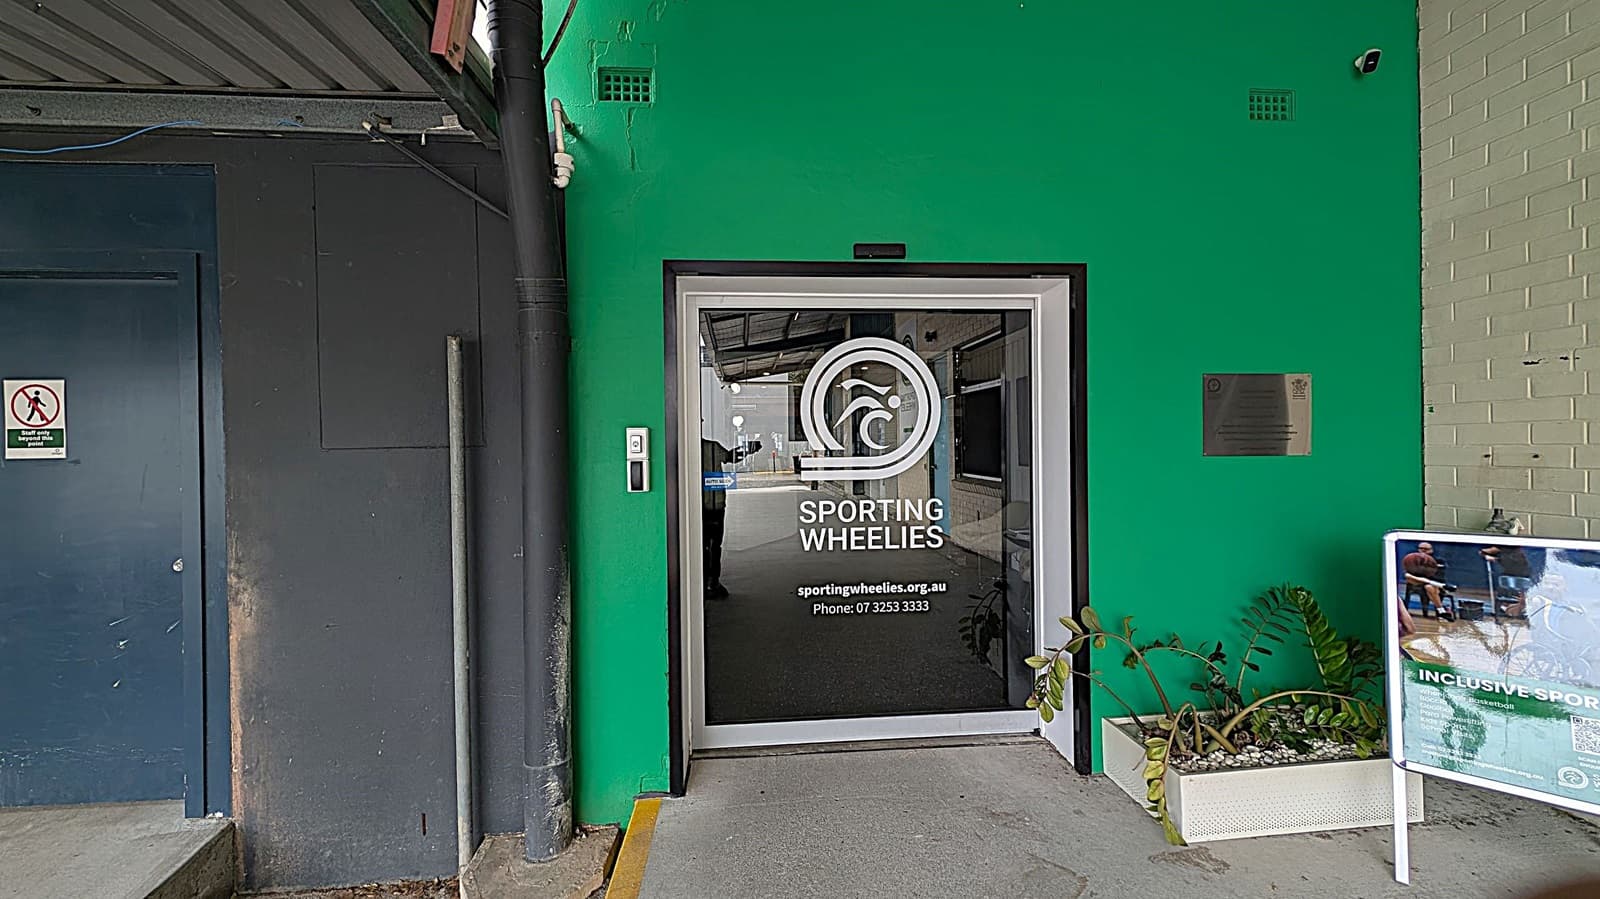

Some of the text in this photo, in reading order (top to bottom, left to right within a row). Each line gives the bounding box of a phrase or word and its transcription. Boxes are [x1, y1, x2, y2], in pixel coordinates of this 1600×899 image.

[799, 499, 944, 524] SPORTING
[800, 525, 944, 552] WHEELIES
[797, 582, 947, 598] sportingwheelies.org.au
[813, 601, 930, 615] Phone: 07 3253 3333
[1419, 669, 1600, 710] INCLUSIVE SPOR
[1468, 697, 1515, 710] Basketball
